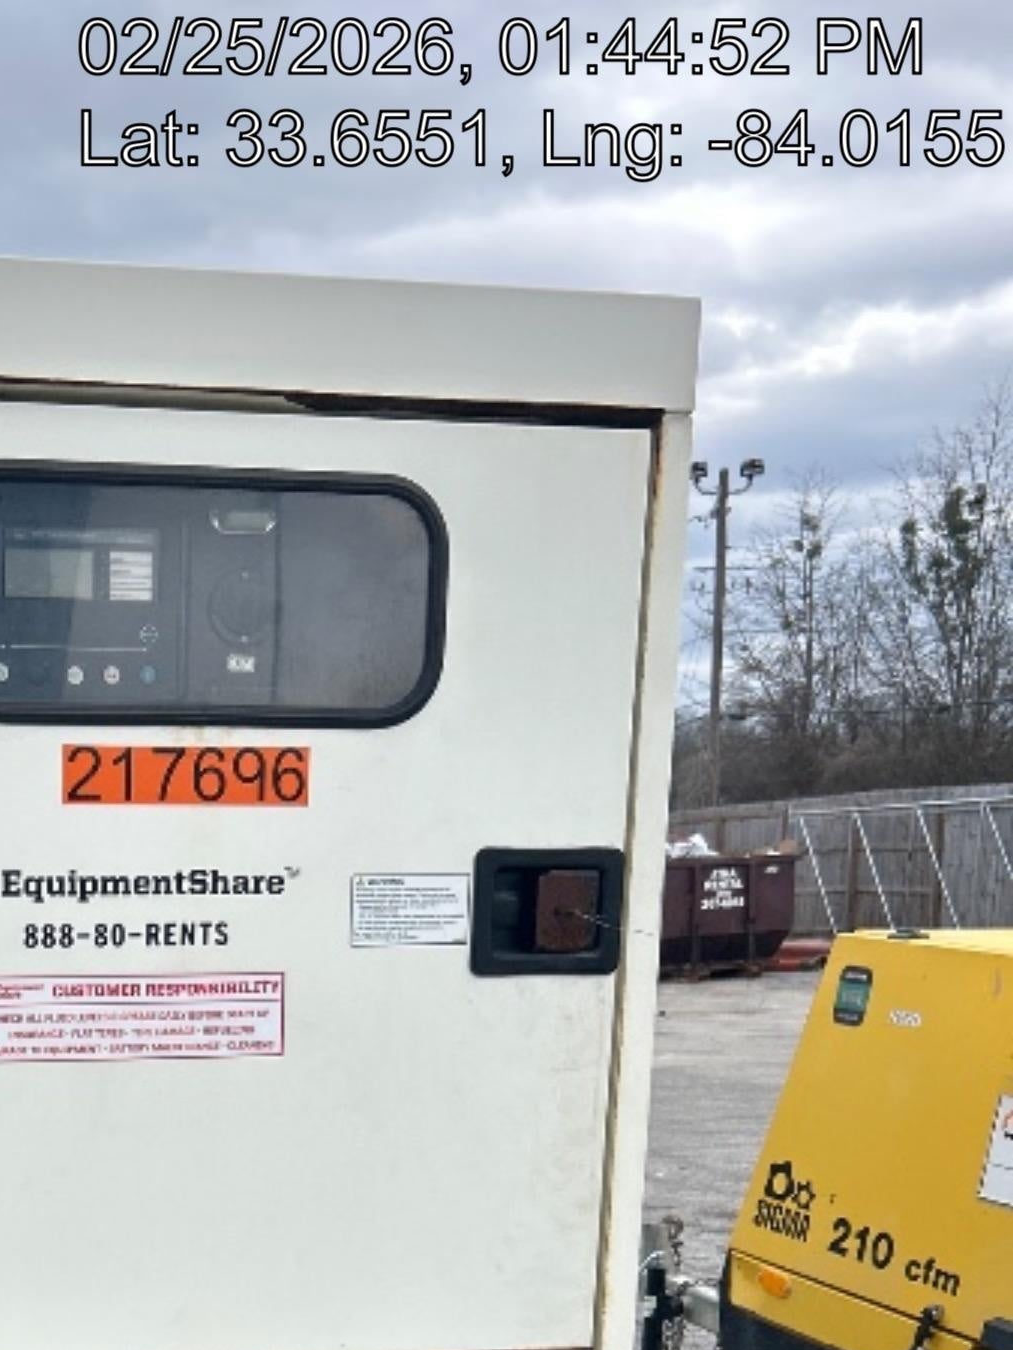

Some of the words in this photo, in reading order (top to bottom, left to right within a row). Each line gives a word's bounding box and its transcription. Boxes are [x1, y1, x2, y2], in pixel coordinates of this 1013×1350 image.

[66, 746, 306, 802] 217696
[0, 868, 287, 903] EquipmentShare
[23, 921, 229, 949] 888-80-RENTS
[52, 982, 141, 998] CUSTOMER
[827, 1216, 895, 1270] 210
[904, 1256, 961, 1297] cfm
